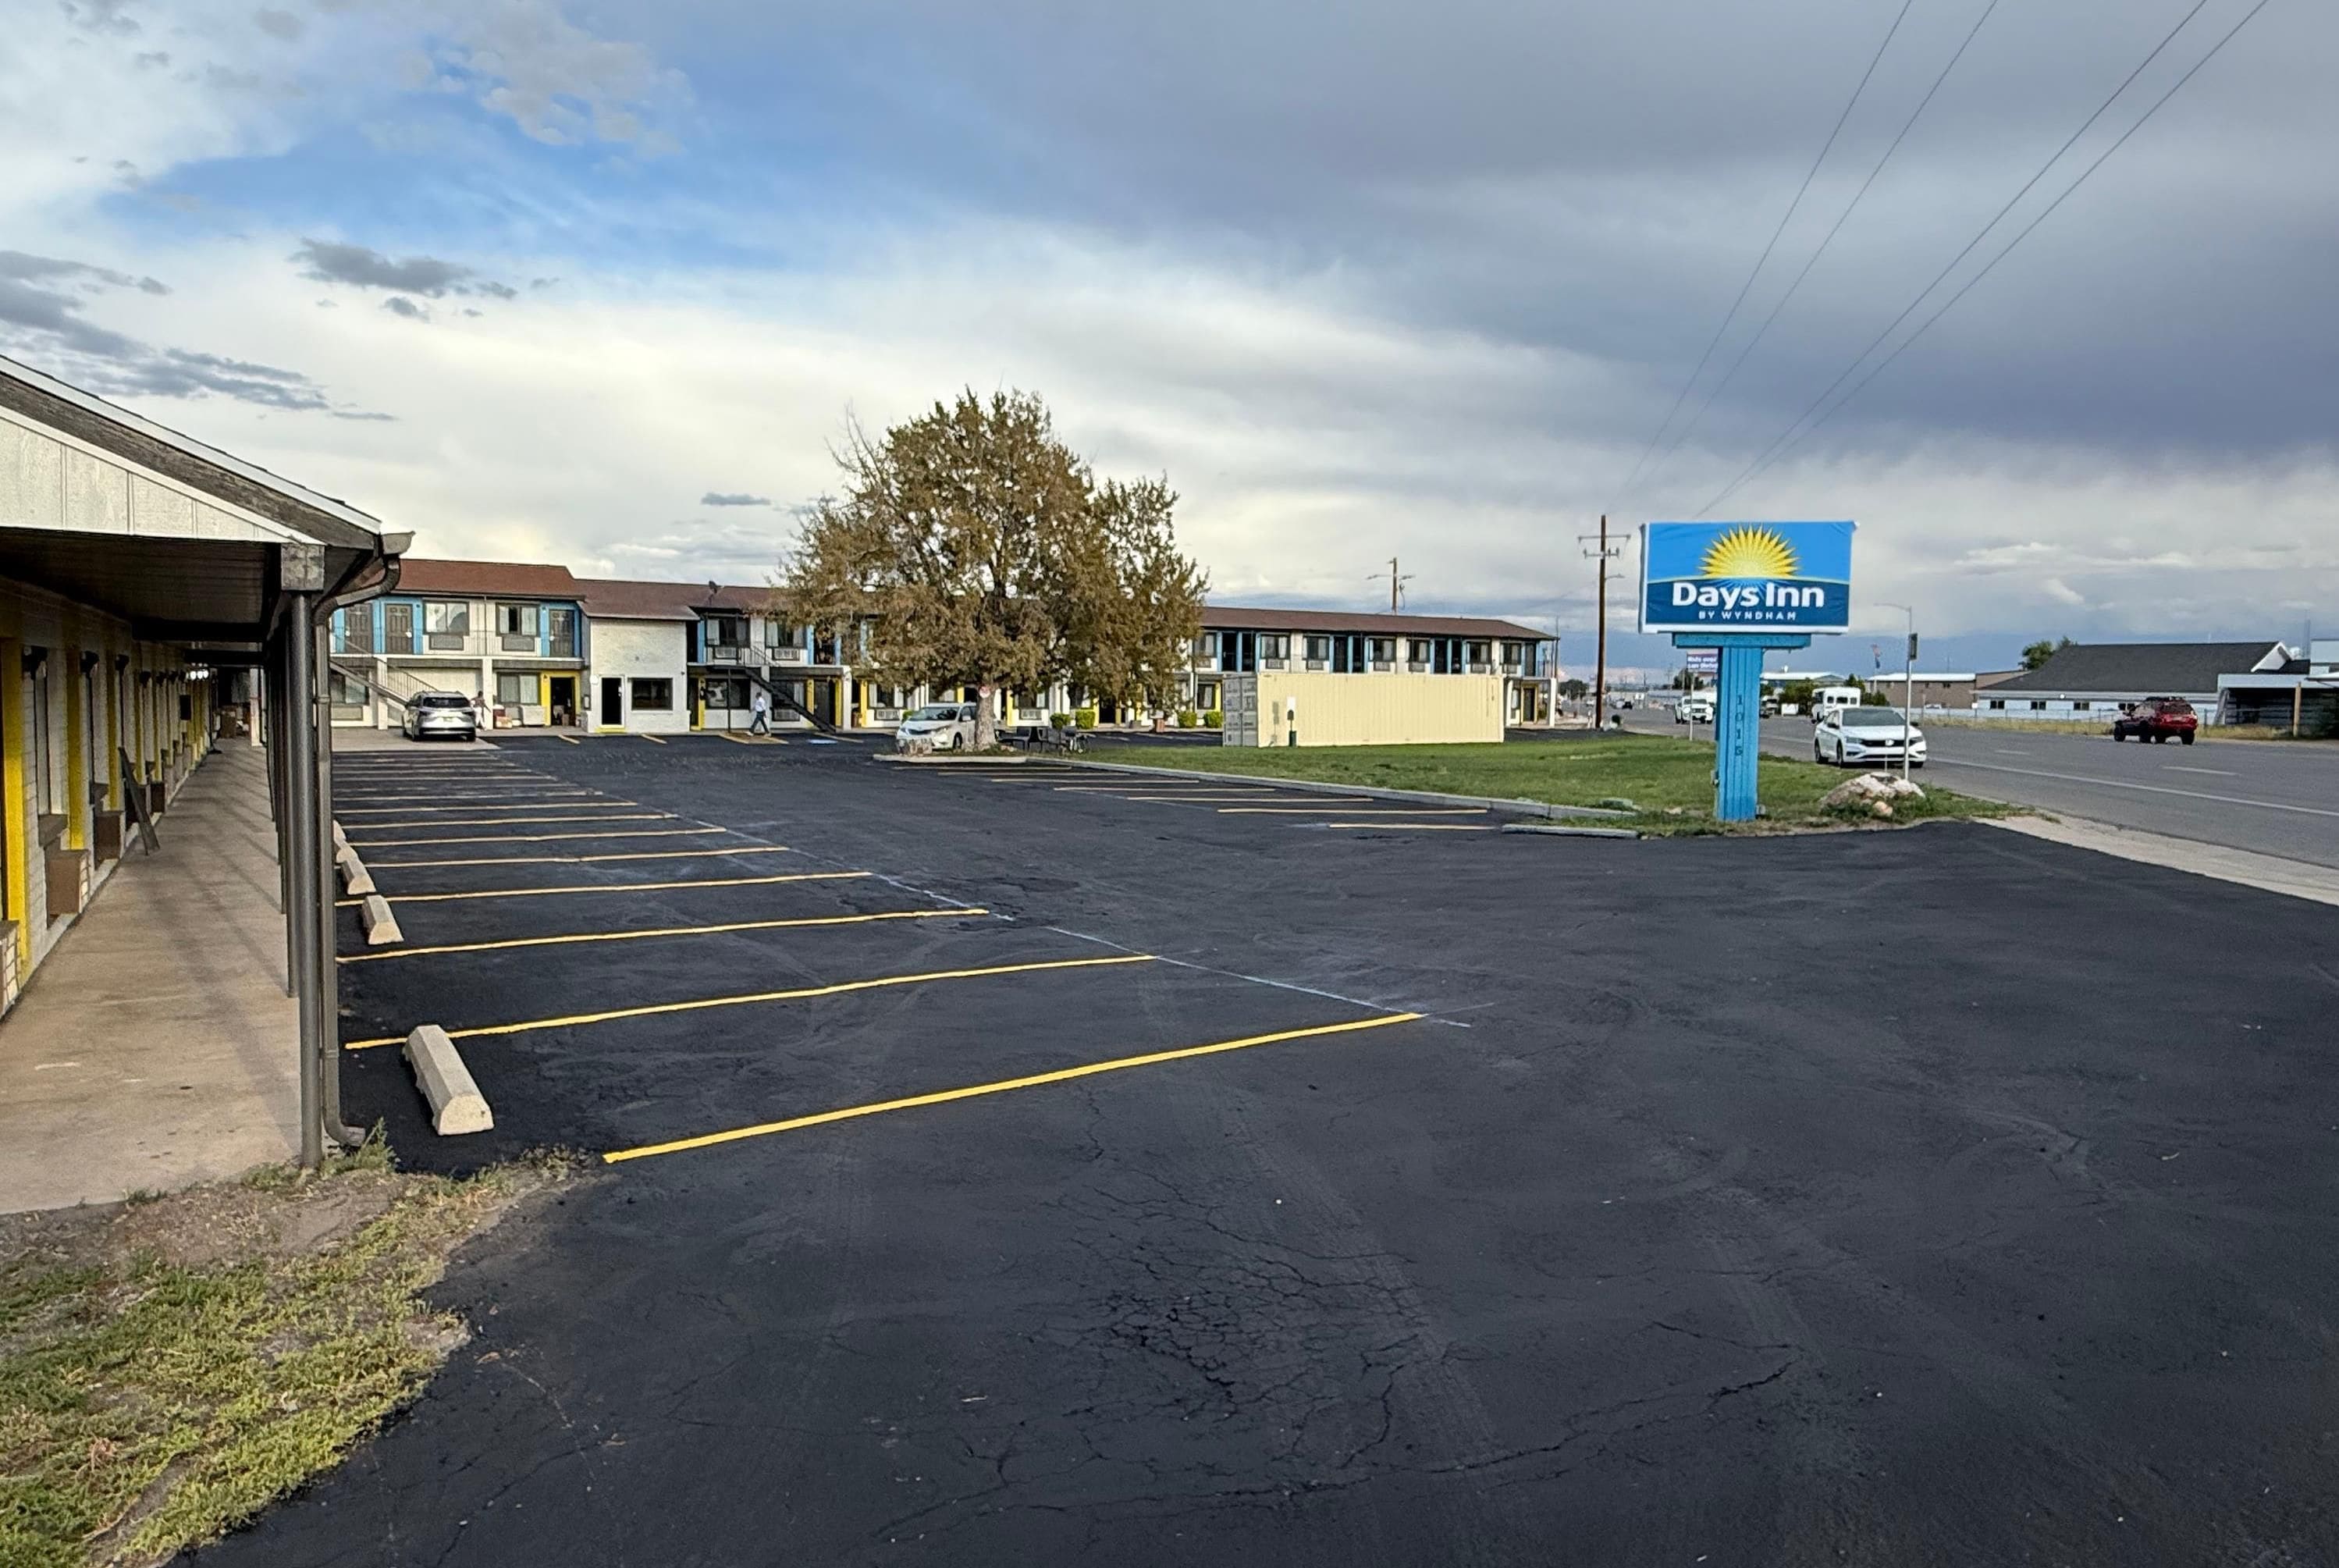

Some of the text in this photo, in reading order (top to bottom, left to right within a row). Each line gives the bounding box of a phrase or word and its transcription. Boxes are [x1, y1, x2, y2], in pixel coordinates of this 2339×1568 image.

[1672, 581, 1825, 610] Days Inn
[1698, 610, 1797, 620] BY WYNDHAM
